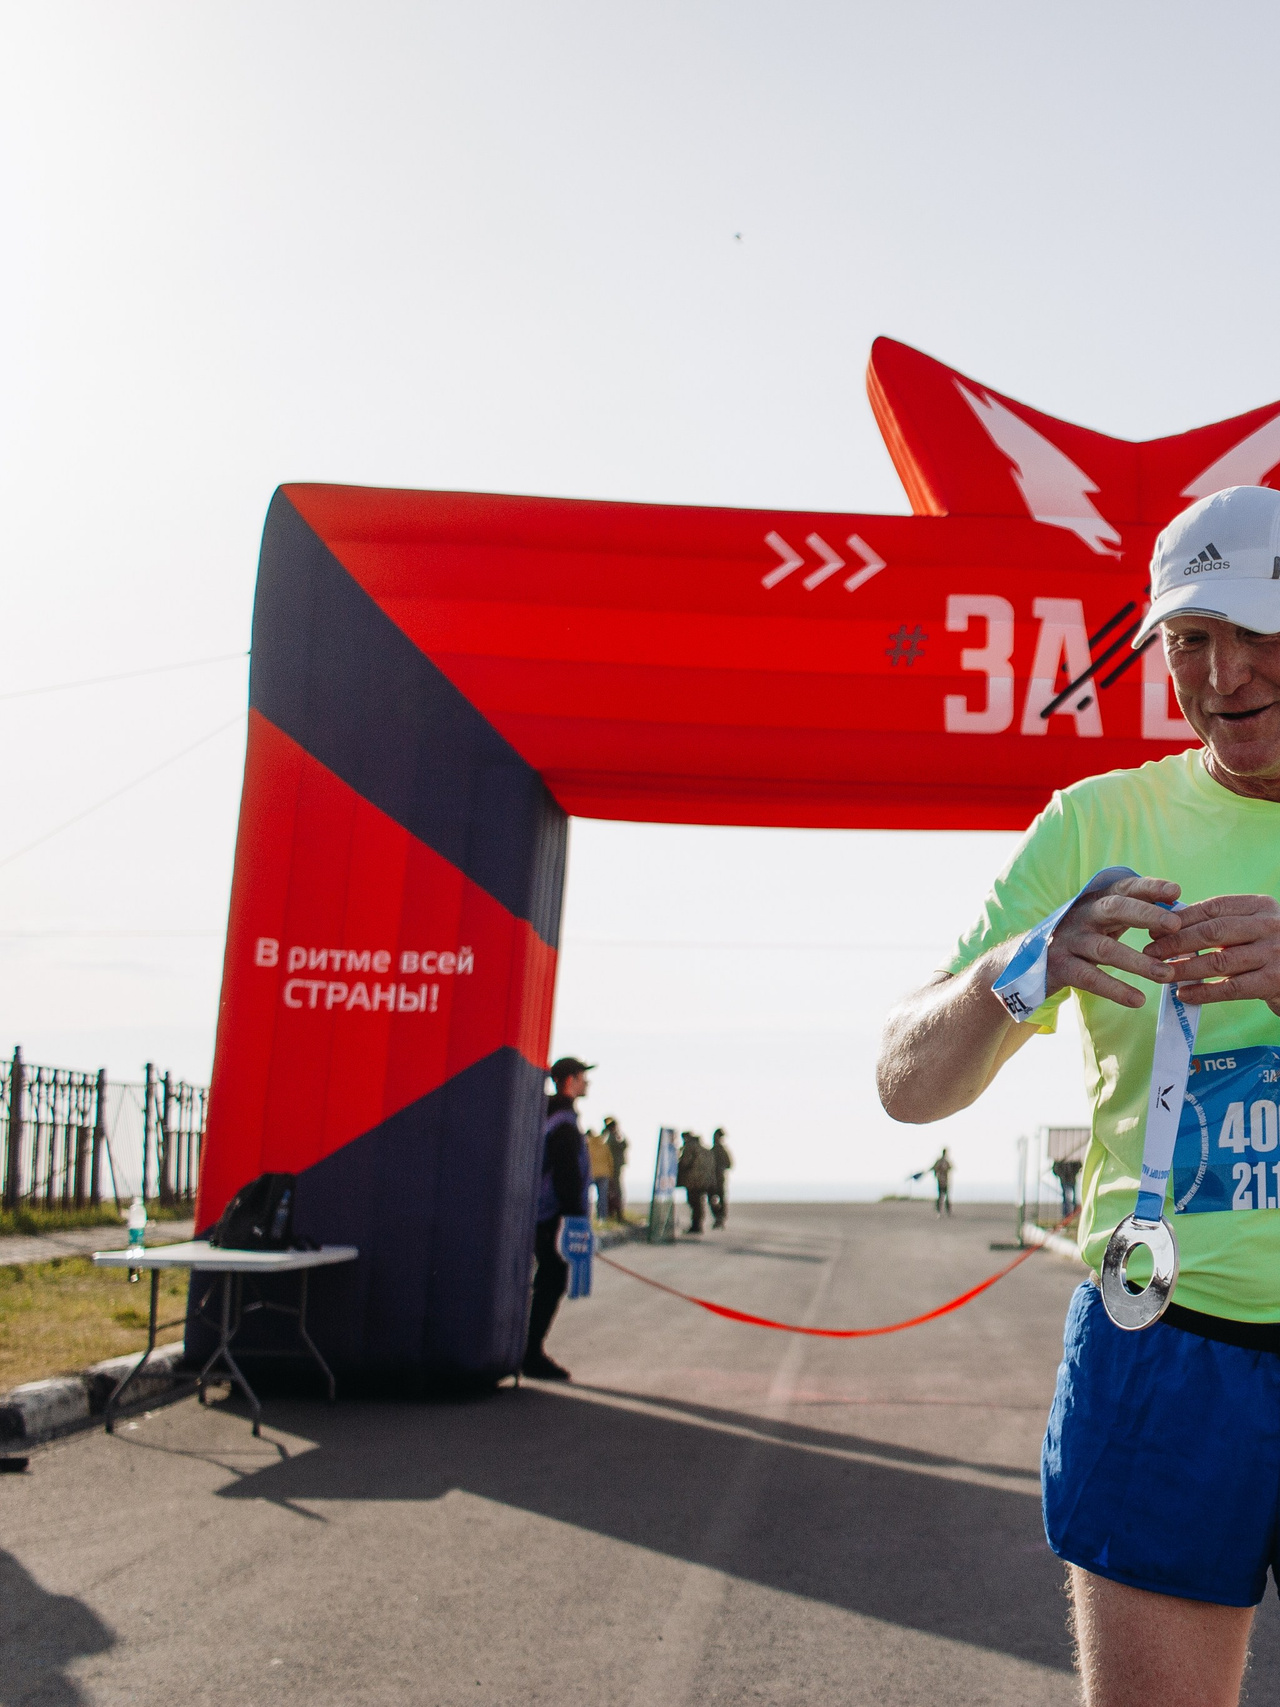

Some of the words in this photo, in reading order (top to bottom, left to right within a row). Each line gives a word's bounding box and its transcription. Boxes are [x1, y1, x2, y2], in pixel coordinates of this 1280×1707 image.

[1183, 558, 1231, 576] adidas
[255, 937, 279, 968] В
[287, 946, 392, 974] ритме
[400, 945, 475, 975] всей
[283, 978, 440, 1013] СТРАНЫ!
[1204, 1057, 1237, 1071] ПСБ
